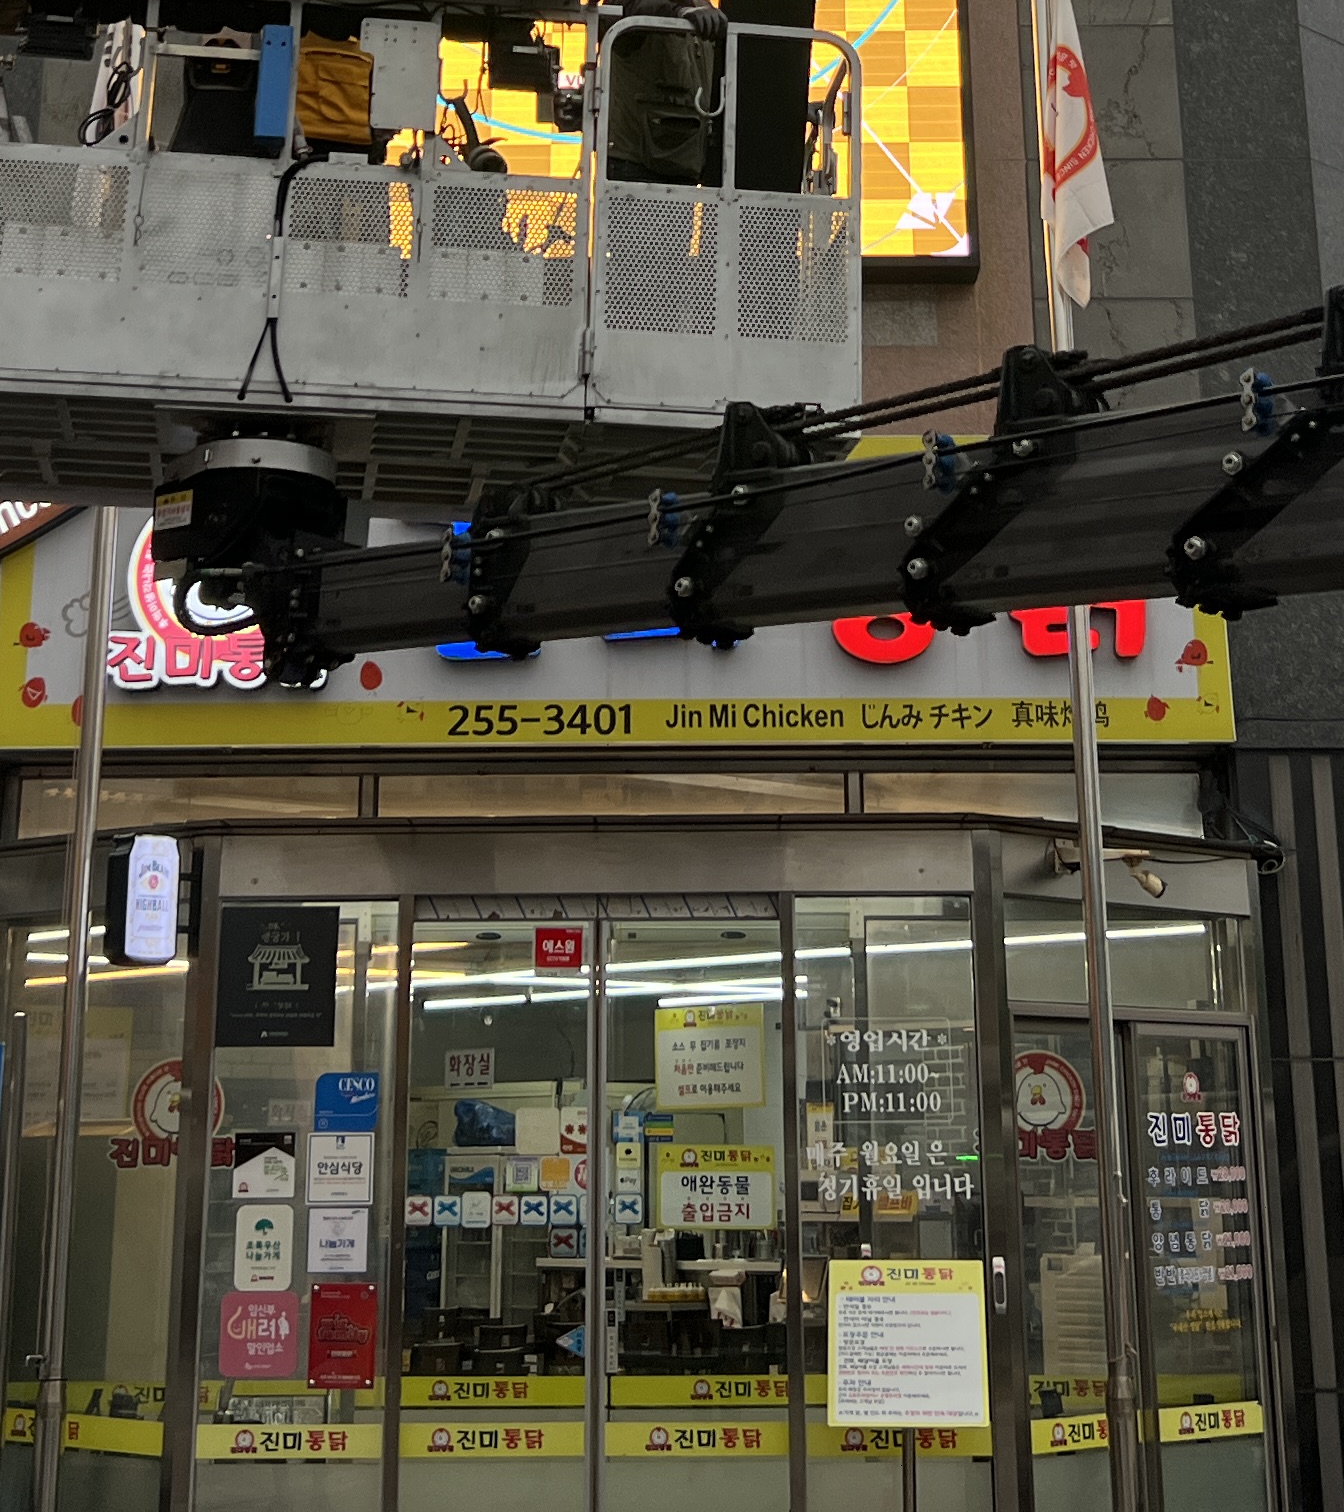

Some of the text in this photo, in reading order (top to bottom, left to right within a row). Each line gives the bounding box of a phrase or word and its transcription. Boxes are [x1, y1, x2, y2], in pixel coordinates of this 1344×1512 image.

[107, 632, 265, 683] 진미통
[447, 702, 845, 737] 255-3401 Jin Mi Chicken
[929, 703, 993, 729] チキン
[840, 1029, 932, 1053] 영업시간
[449, 1052, 490, 1077] 화장실
[338, 1077, 376, 1092] CESCO
[842, 1091, 942, 1113] PM:11:00
[1147, 1111, 1241, 1148] 진미통닭
[108, 1134, 236, 1168] 진미닭
[700, 1149, 752, 1163] 진미통닭
[805, 1139, 948, 1168] 매주 월요일 은
[1017, 1128, 1097, 1161] 미통닭
[317, 1161, 363, 1176] 안심식당
[1147, 1166, 1209, 1188] 후라이드
[681, 1175, 750, 1196] 애완동물
[818, 1172, 975, 1201] 정기휴일 입니다
[681, 1202, 751, 1224] 출입금지
[886, 1266, 955, 1282] 진미통닭
[453, 1380, 529, 1401] 진미통닭
[714, 1380, 789, 1400] 진미통닭
[1067, 1418, 1108, 1444] 진미통
[1194, 1408, 1246, 1433] 진미통닭
[260, 1429, 349, 1453] 진미통닭
[456, 1428, 545, 1451] 진미통닭
[674, 1427, 763, 1450] 진미통닭
